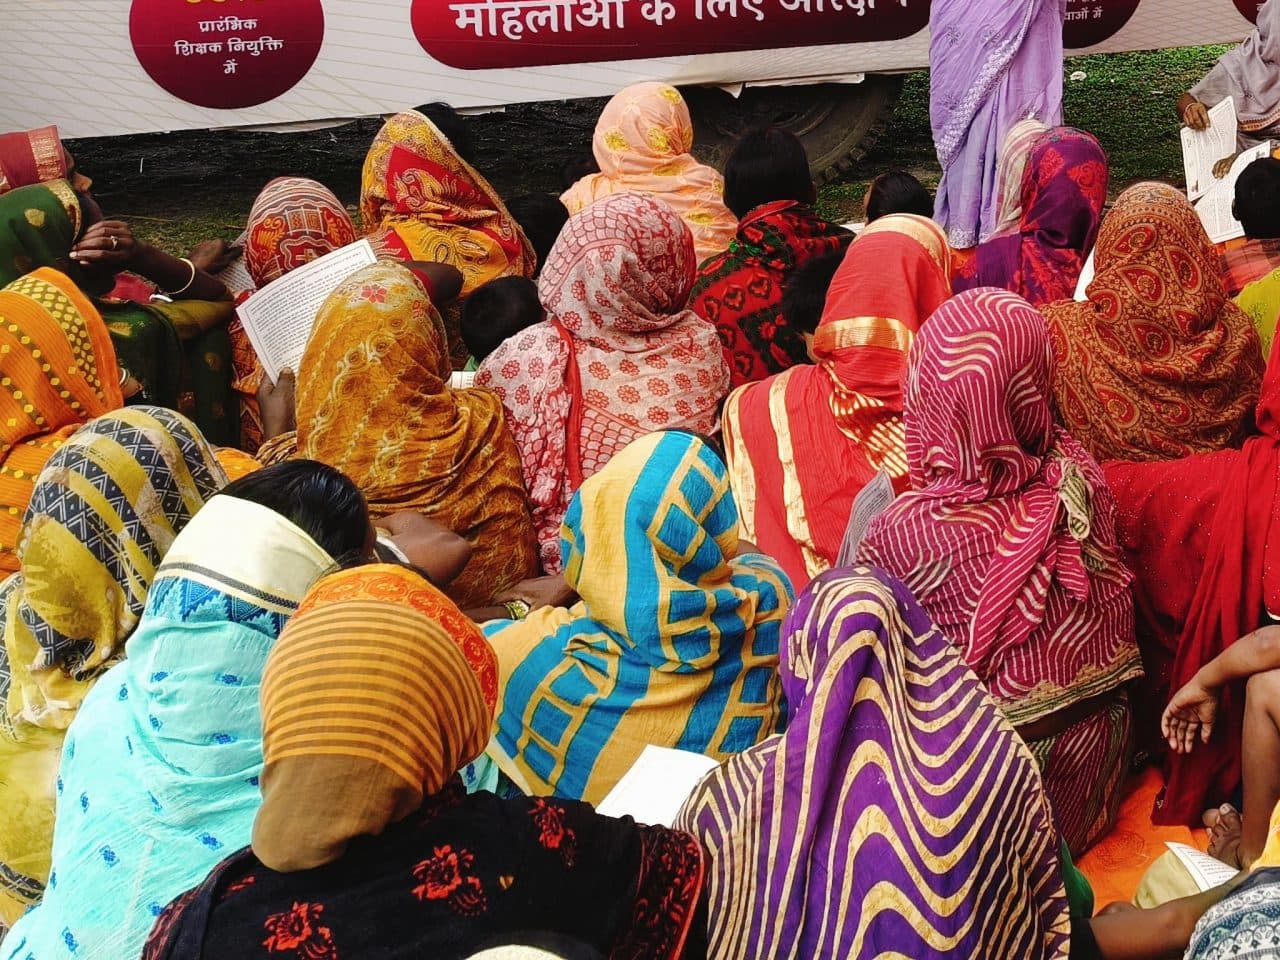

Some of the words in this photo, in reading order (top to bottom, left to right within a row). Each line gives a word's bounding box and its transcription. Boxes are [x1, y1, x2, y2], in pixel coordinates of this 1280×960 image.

[1093, 6, 1103, 19] में
[199, 16, 258, 34] प्रारंभिक
[174, 37, 222, 56] शिक्षक
[228, 36, 284, 57] नियुक्ति
[223, 58, 238, 76] में
